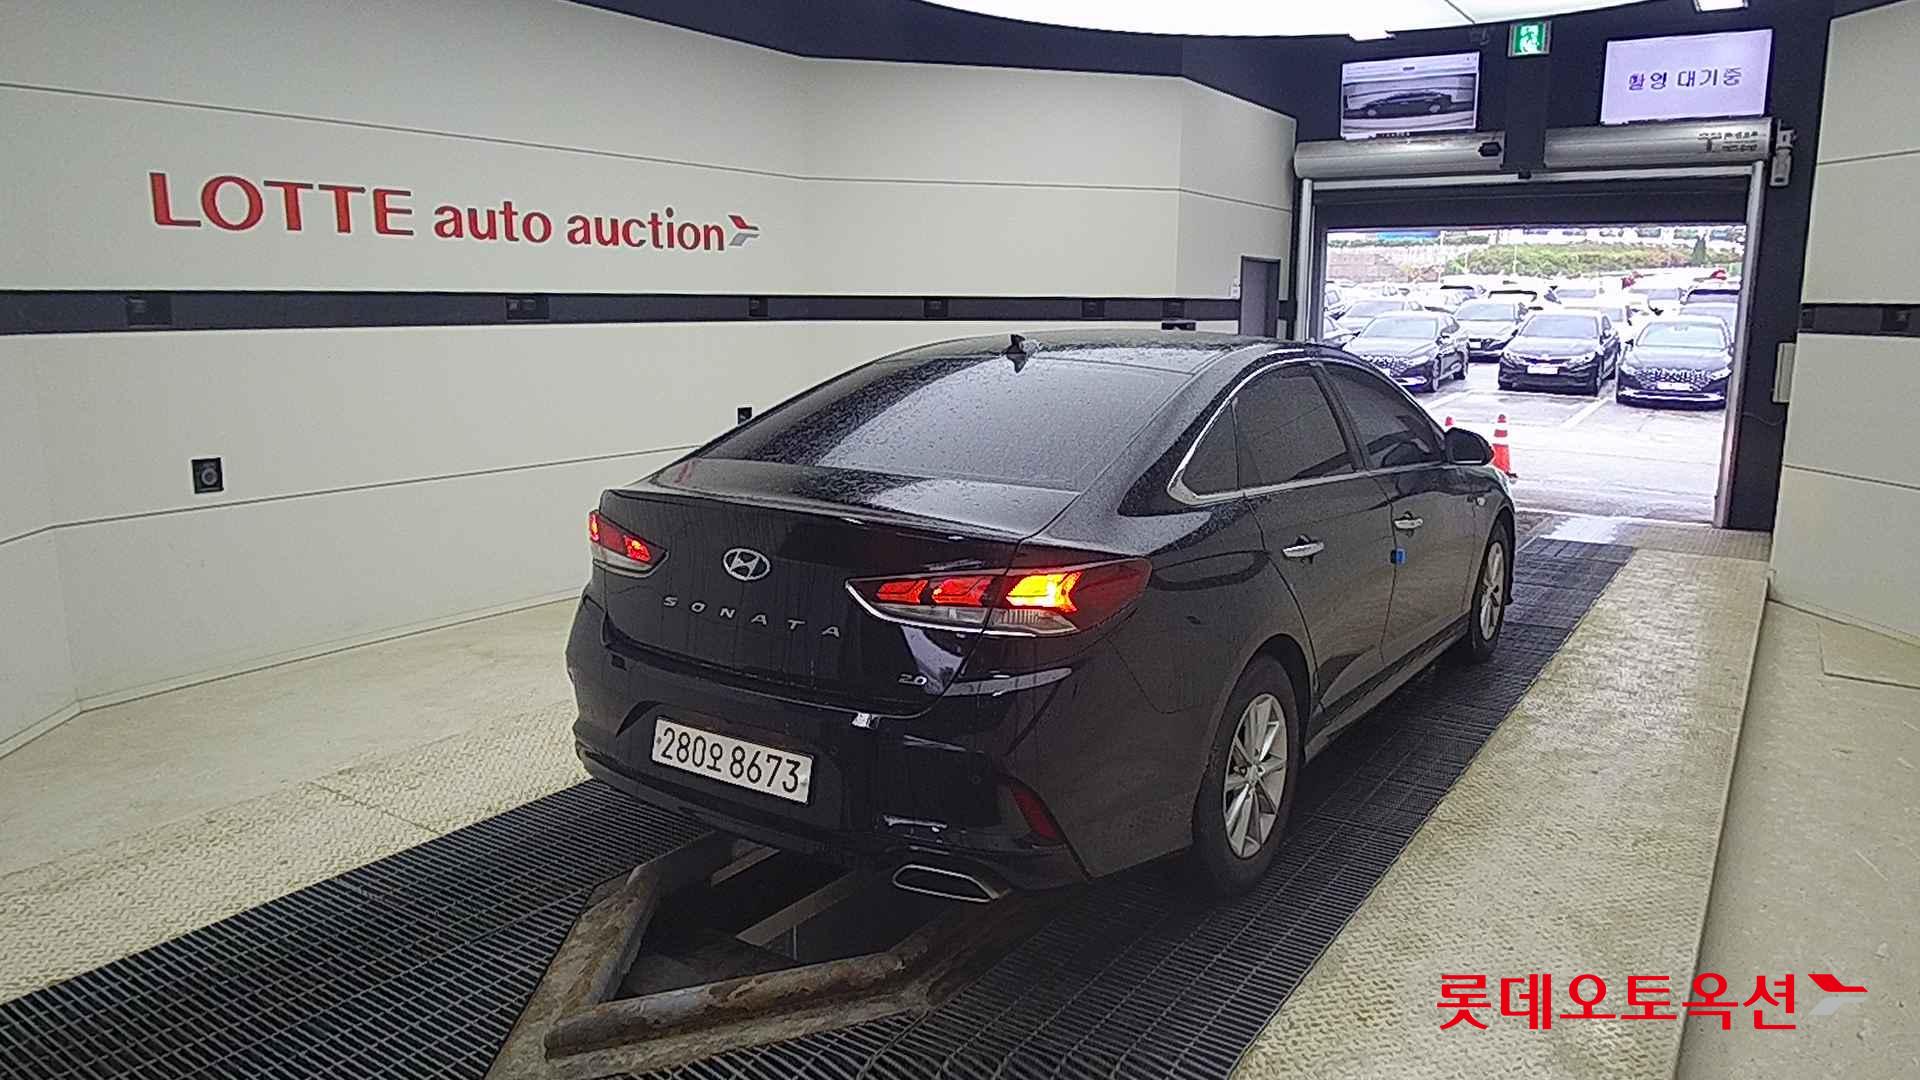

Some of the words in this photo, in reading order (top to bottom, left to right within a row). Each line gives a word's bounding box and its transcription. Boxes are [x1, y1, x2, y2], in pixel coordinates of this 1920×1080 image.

[1677, 67, 1742, 87] 대기중
[149, 172, 414, 236] LOTTE
[433, 199, 552, 244] auto
[566, 207, 725, 251] auction
[663, 596, 841, 638] SONATA
